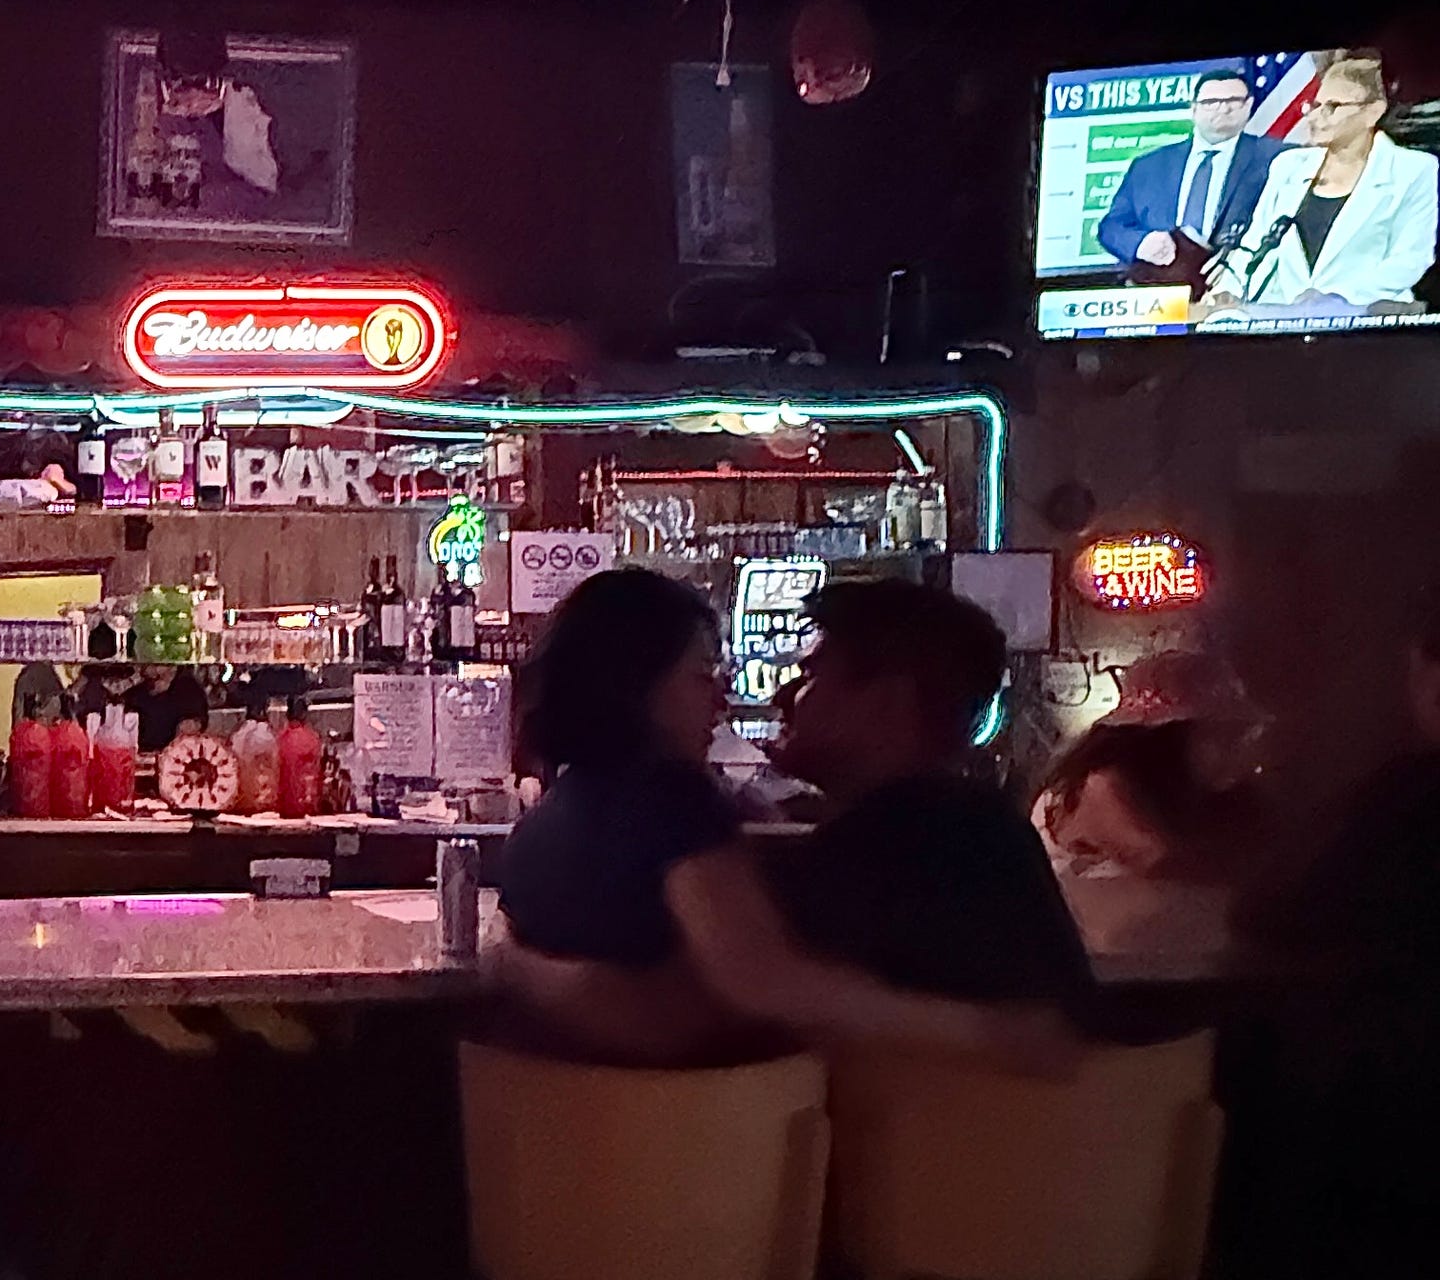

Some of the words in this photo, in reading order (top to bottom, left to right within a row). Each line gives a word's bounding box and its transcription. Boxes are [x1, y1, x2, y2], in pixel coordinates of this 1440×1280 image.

[1055, 85, 1084, 111] VS
[1087, 80, 1141, 109] THIS
[1083, 299, 1128, 317] CBS
[144, 311, 360, 357] Budweiser
[234, 444, 380, 507] BAR
[1092, 545, 1172, 576] BEER
